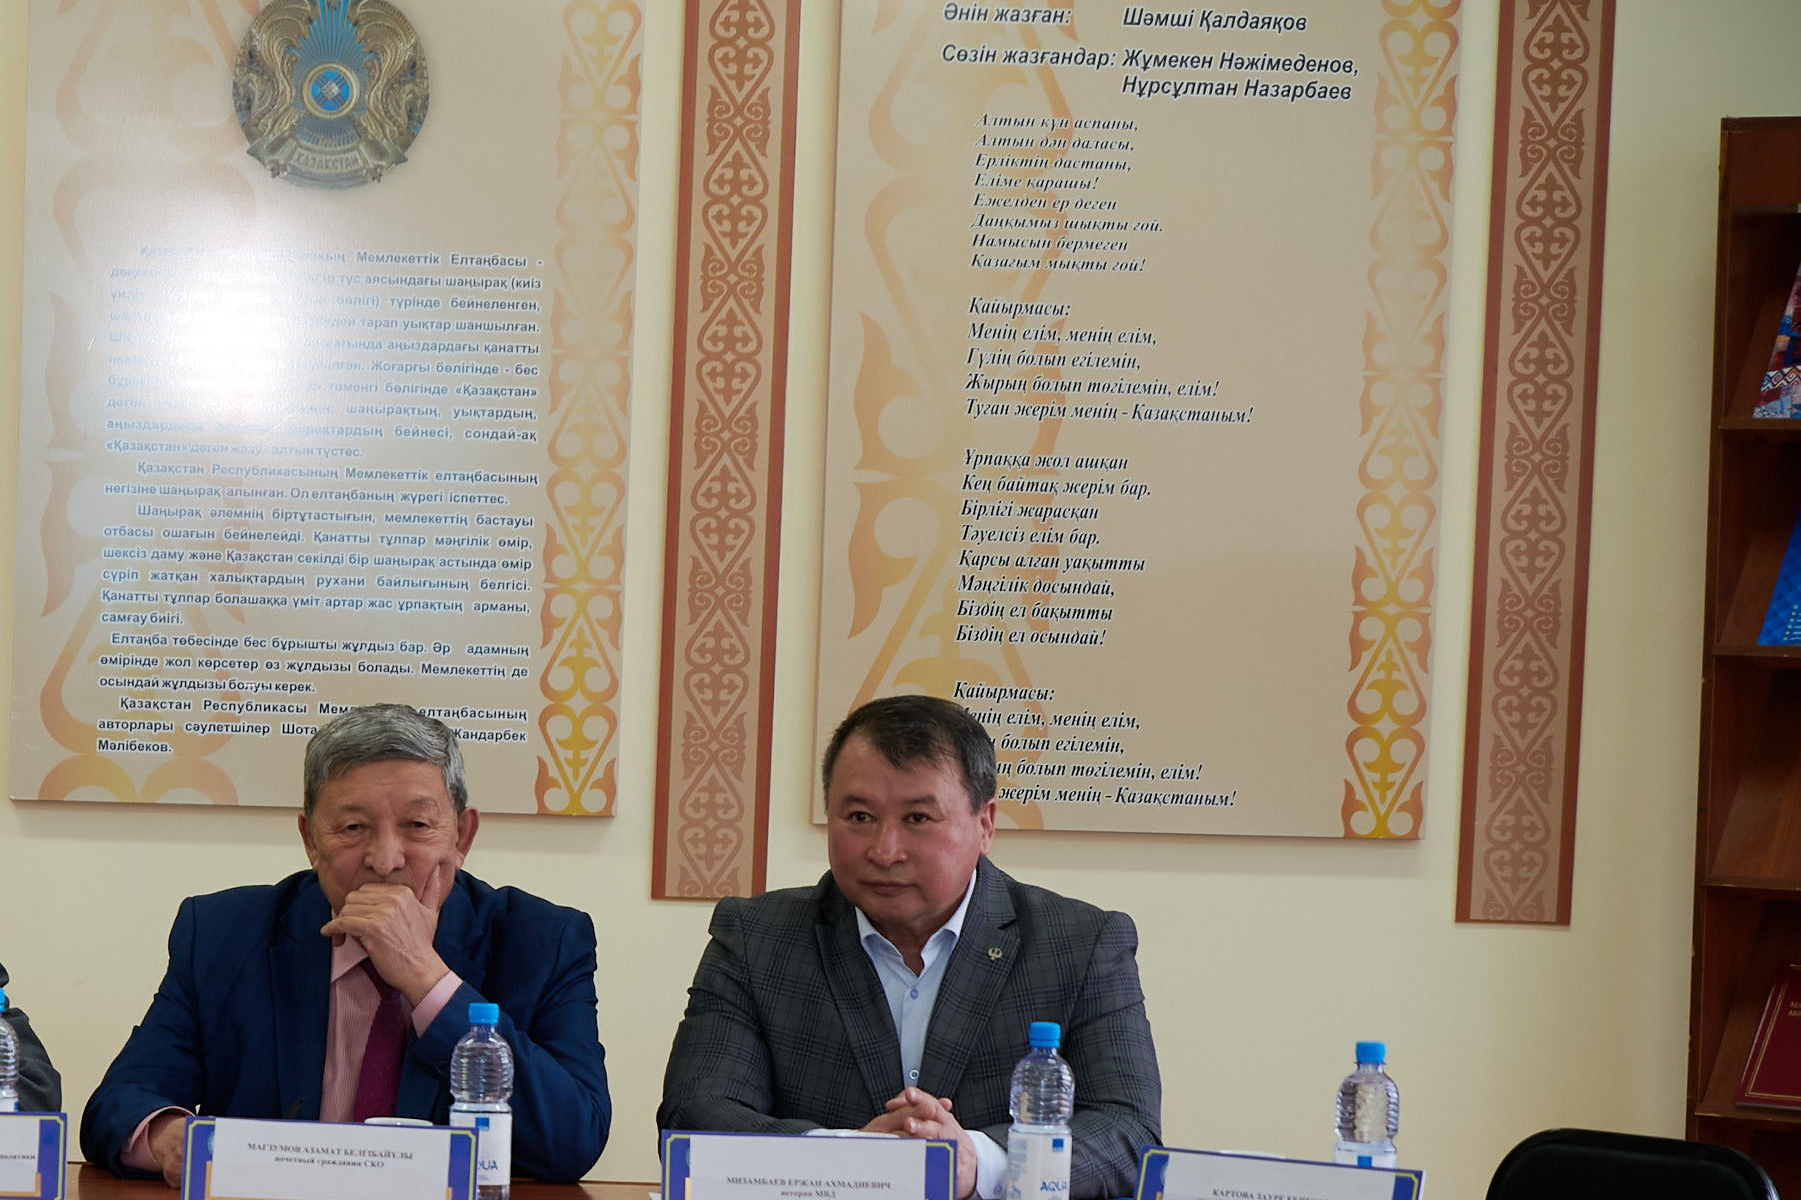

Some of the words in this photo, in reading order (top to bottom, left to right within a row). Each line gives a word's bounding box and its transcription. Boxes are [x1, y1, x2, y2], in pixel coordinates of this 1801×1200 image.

[943, 2, 989, 21] Әнін
[993, 8, 1071, 24] жазған:
[1122, 7, 1195, 27] Шәмші
[1198, 9, 1307, 34] Қалдаяқов
[942, 44, 997, 63] Сөзін
[1001, 46, 1116, 71] жазғандар:
[1121, 48, 1213, 72] Жұмекен
[1218, 51, 1358, 77] Нәжімеденов,
[1121, 75, 1238, 99] Нұрсұлтан
[1243, 78, 1352, 102] Назарбаев
[971, 233, 1051, 249] Намысын
[1056, 236, 1128, 253] бермеген
[357, 250, 440, 264] Мемлекеттік
[450, 253, 527, 267] Елтаңбасы
[966, 322, 1017, 340] Менің
[1065, 326, 1113, 343] менің
[965, 372, 1027, 395] Жырың
[1032, 375, 1082, 392] болып
[1034, 455, 1070, 468] жол
[1074, 457, 1128, 470] ашқан
[961, 473, 992, 493] Кең
[996, 475, 1059, 493] байтақ
[1061, 478, 1115, 499] жерім
[1119, 478, 1151, 500] бар.
[960, 499, 1014, 520] Бірлігі
[1016, 505, 1099, 523] жарасқан
[103, 527, 153, 537] отбасы
[162, 529, 215, 539] ошағын
[313, 530, 370, 544] Қанатты
[378, 535, 426, 548] тұлпар
[434, 535, 489, 548] мәңгілік
[957, 574, 1029, 592] Мәңгілік
[102, 589, 158, 602] Қанатты
[163, 593, 210, 606] тұлпар
[214, 592, 287, 607] болашаққа
[292, 595, 320, 609] үміт
[324, 598, 363, 610] артар
[367, 599, 393, 609] жас
[397, 600, 463, 612] ұрпақтың
[956, 599, 1005, 618] Біздің
[1009, 606, 1026, 618] ел
[1031, 602, 1113, 620] бақытты
[955, 624, 1004, 642] Біздің
[1007, 631, 1025, 643] ел
[111, 632, 167, 646] Елтаңба
[172, 634, 239, 648] төбесінде
[243, 636, 267, 648] бес
[271, 637, 337, 651] бұрышты
[341, 641, 395, 653] жұлдыз
[399, 641, 427, 655] бар.
[432, 641, 451, 656] Әр
[466, 645, 529, 657] адамның
[97, 720, 173, 733] авторлары
[185, 721, 270, 736] сәулетшілер
[281, 722, 318, 736] Шота
